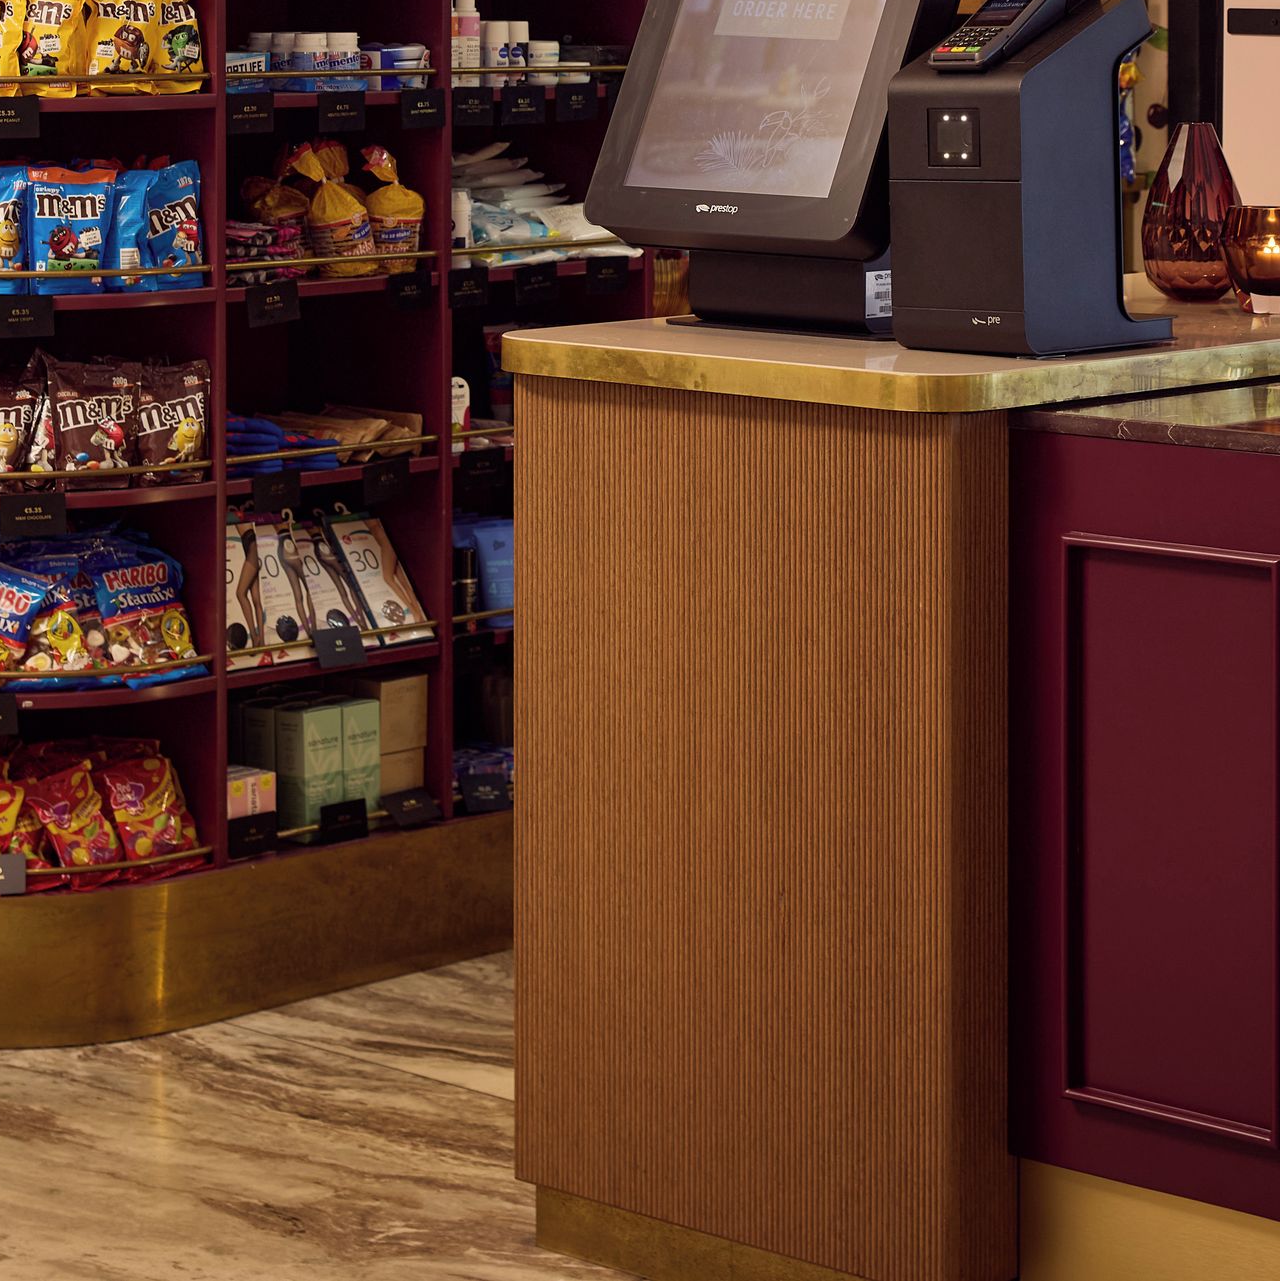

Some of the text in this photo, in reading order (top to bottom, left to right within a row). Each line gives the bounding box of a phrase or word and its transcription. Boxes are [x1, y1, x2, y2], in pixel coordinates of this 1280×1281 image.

[732, 0, 838, 20] ORDER HERE
[35, 192, 106, 220] m&m's
[709, 204, 739, 215] prestop
[57, 395, 133, 431] m&m's
[349, 548, 379, 572] 30
[103, 562, 169, 593] HARIBO
[117, 588, 173, 609] Starmix
